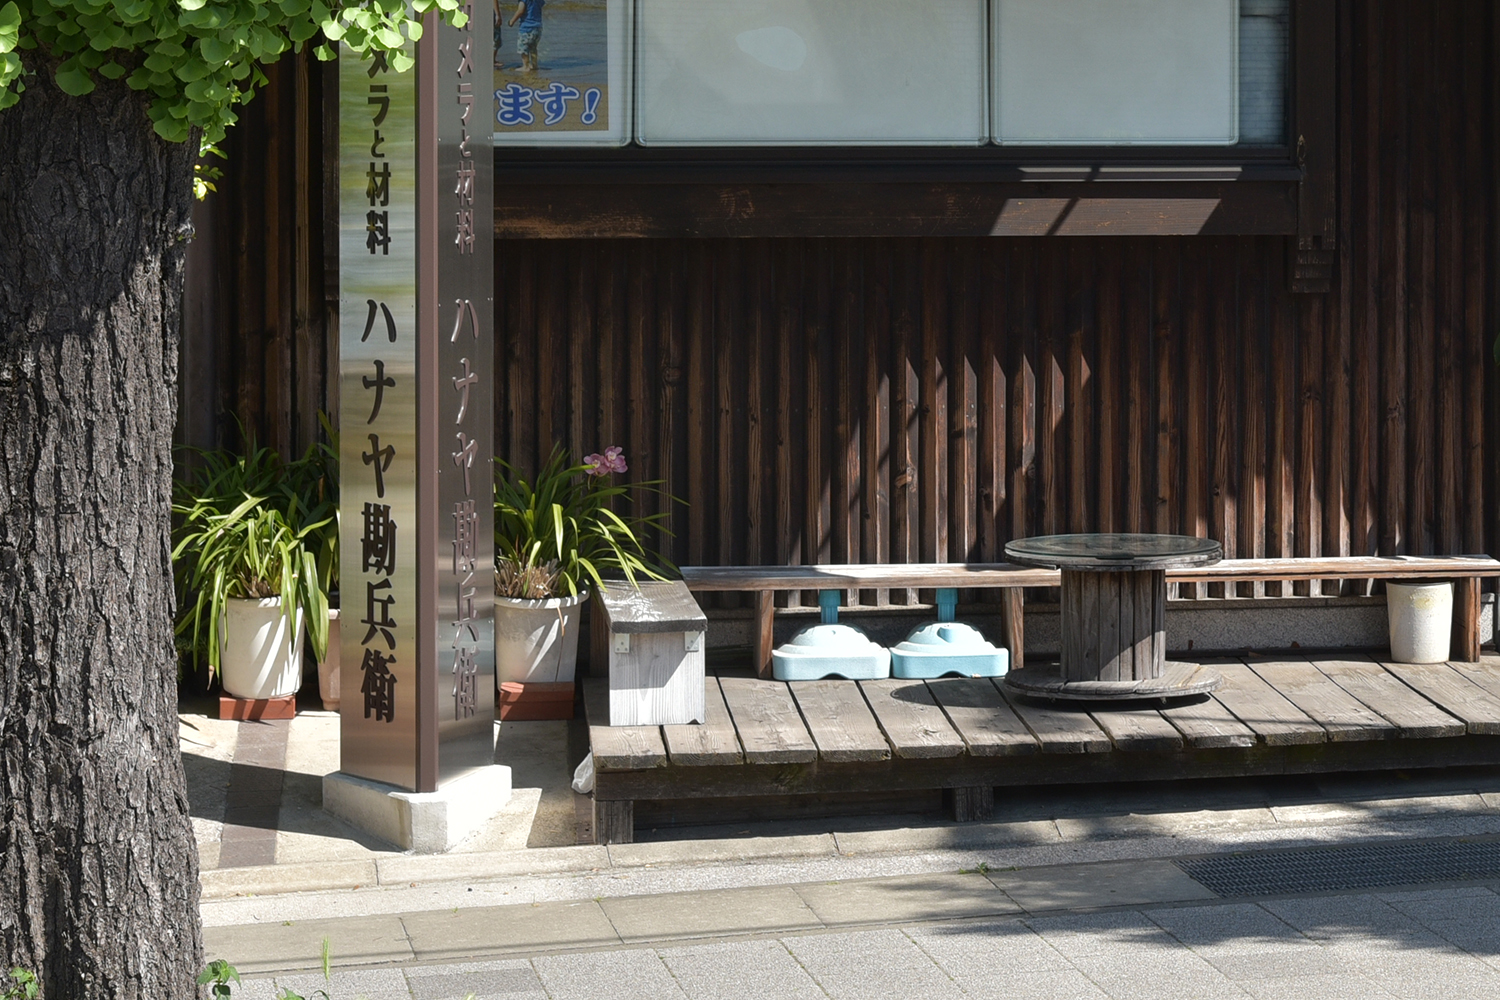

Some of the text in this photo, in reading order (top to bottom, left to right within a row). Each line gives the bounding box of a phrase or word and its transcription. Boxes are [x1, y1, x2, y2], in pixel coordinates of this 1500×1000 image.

[361, 0, 397, 723] メラと材料 ハナヤ勘兵衛
[451, 298, 480, 721] ハナヤ勘兵衛
